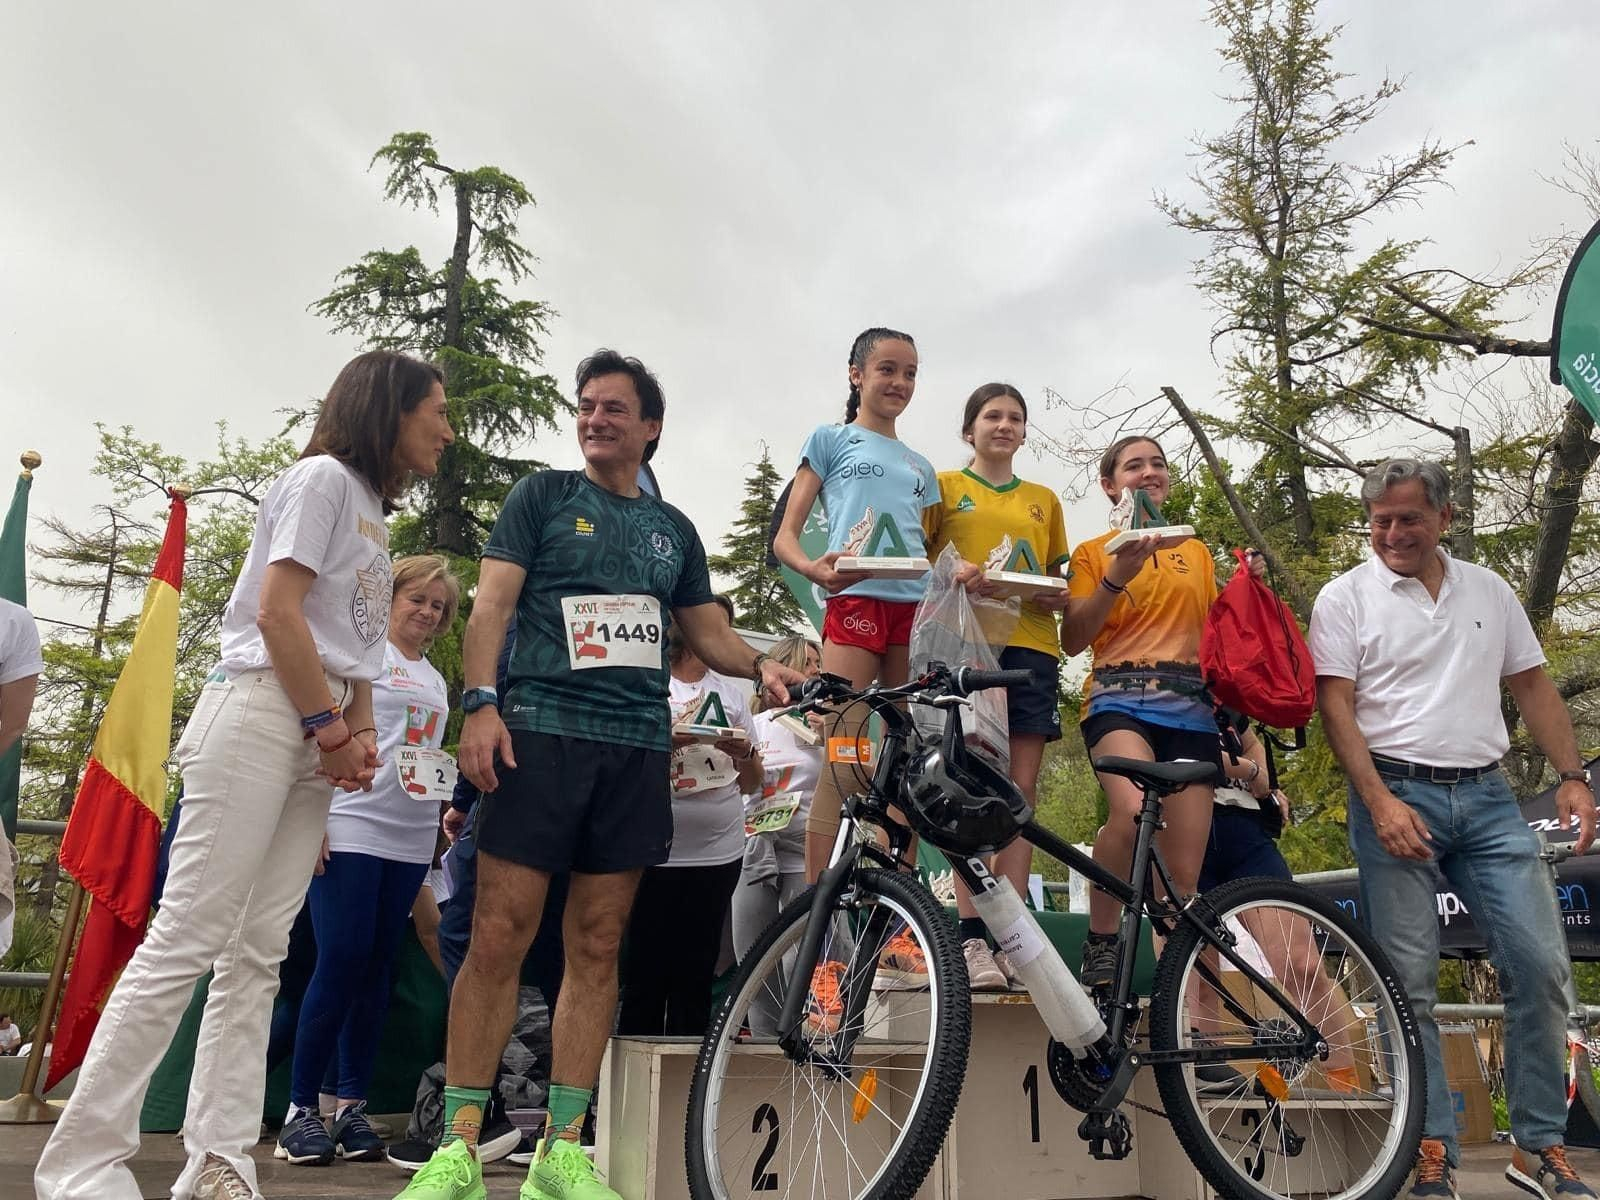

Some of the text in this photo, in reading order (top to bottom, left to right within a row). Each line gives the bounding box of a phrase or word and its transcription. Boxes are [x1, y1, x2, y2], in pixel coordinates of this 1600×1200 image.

[574, 603, 598, 614] XXVI
[597, 623, 660, 644] 1449
[401, 751, 418, 760] XXVI
[705, 757, 715, 771] 1
[435, 769, 446, 784] 2
[755, 808, 793, 826] 5781
[1022, 1064, 1040, 1143] 1
[751, 1102, 780, 1191] 2
[1241, 1108, 1266, 1182] 3
